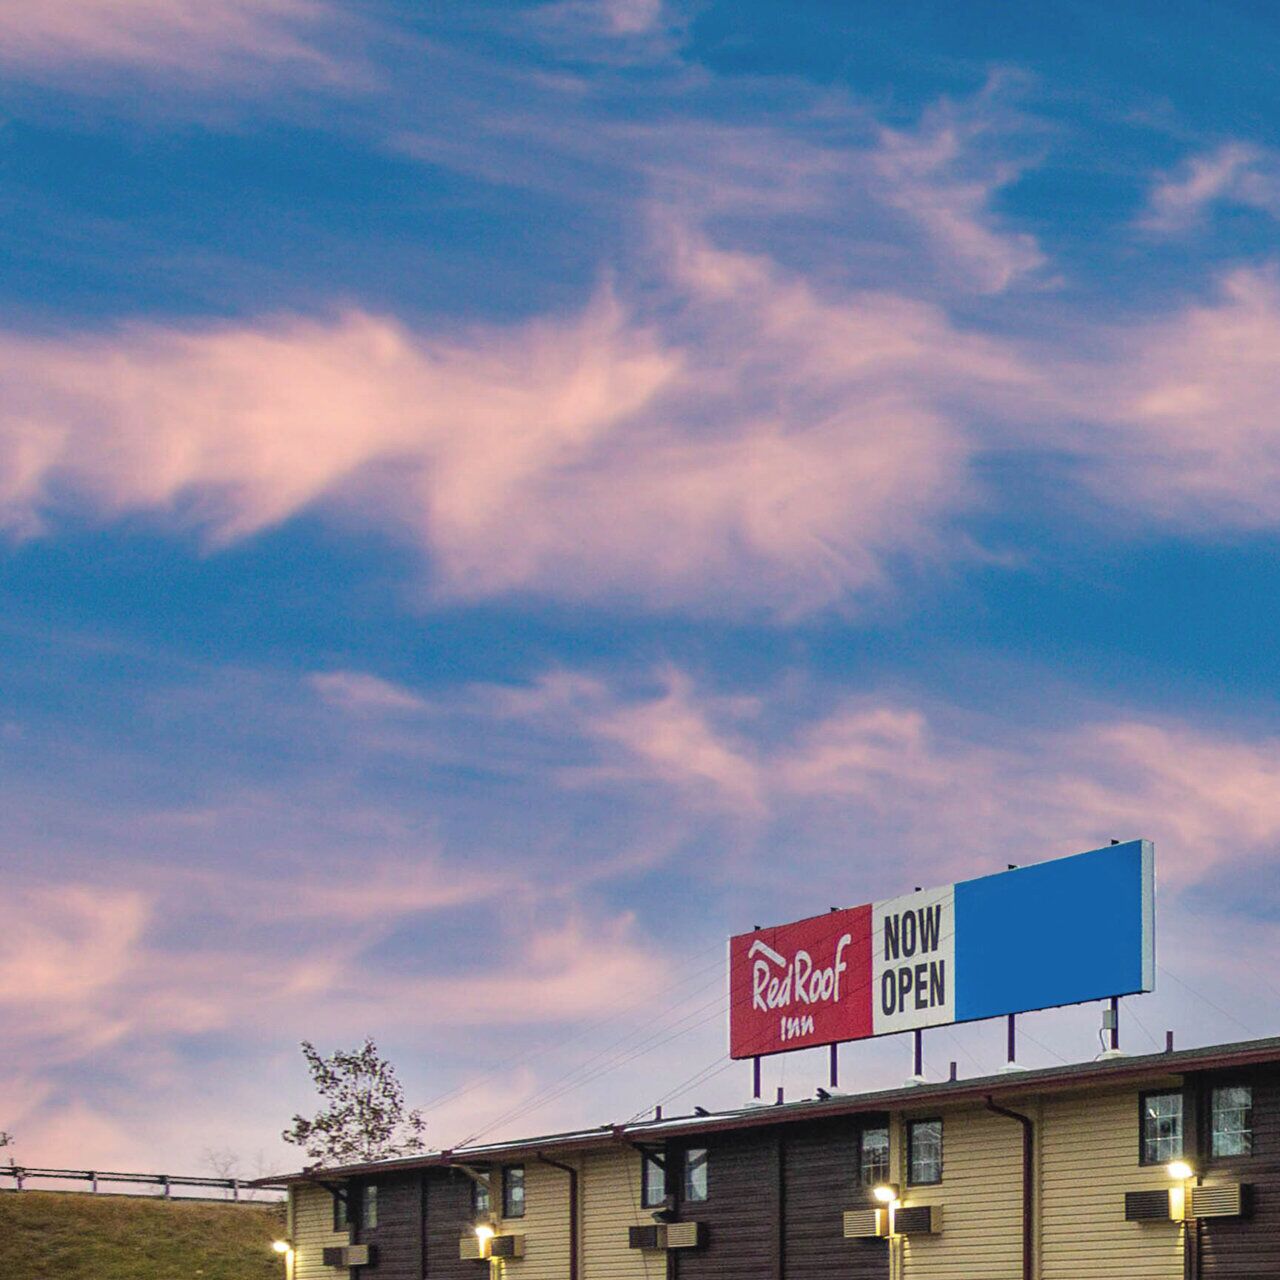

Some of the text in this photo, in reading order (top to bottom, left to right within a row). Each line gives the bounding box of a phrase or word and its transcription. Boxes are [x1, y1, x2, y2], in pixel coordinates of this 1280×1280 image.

[884, 905, 941, 960] NOW
[752, 934, 851, 1012] Red Roof
[882, 960, 945, 1016] OPEN
